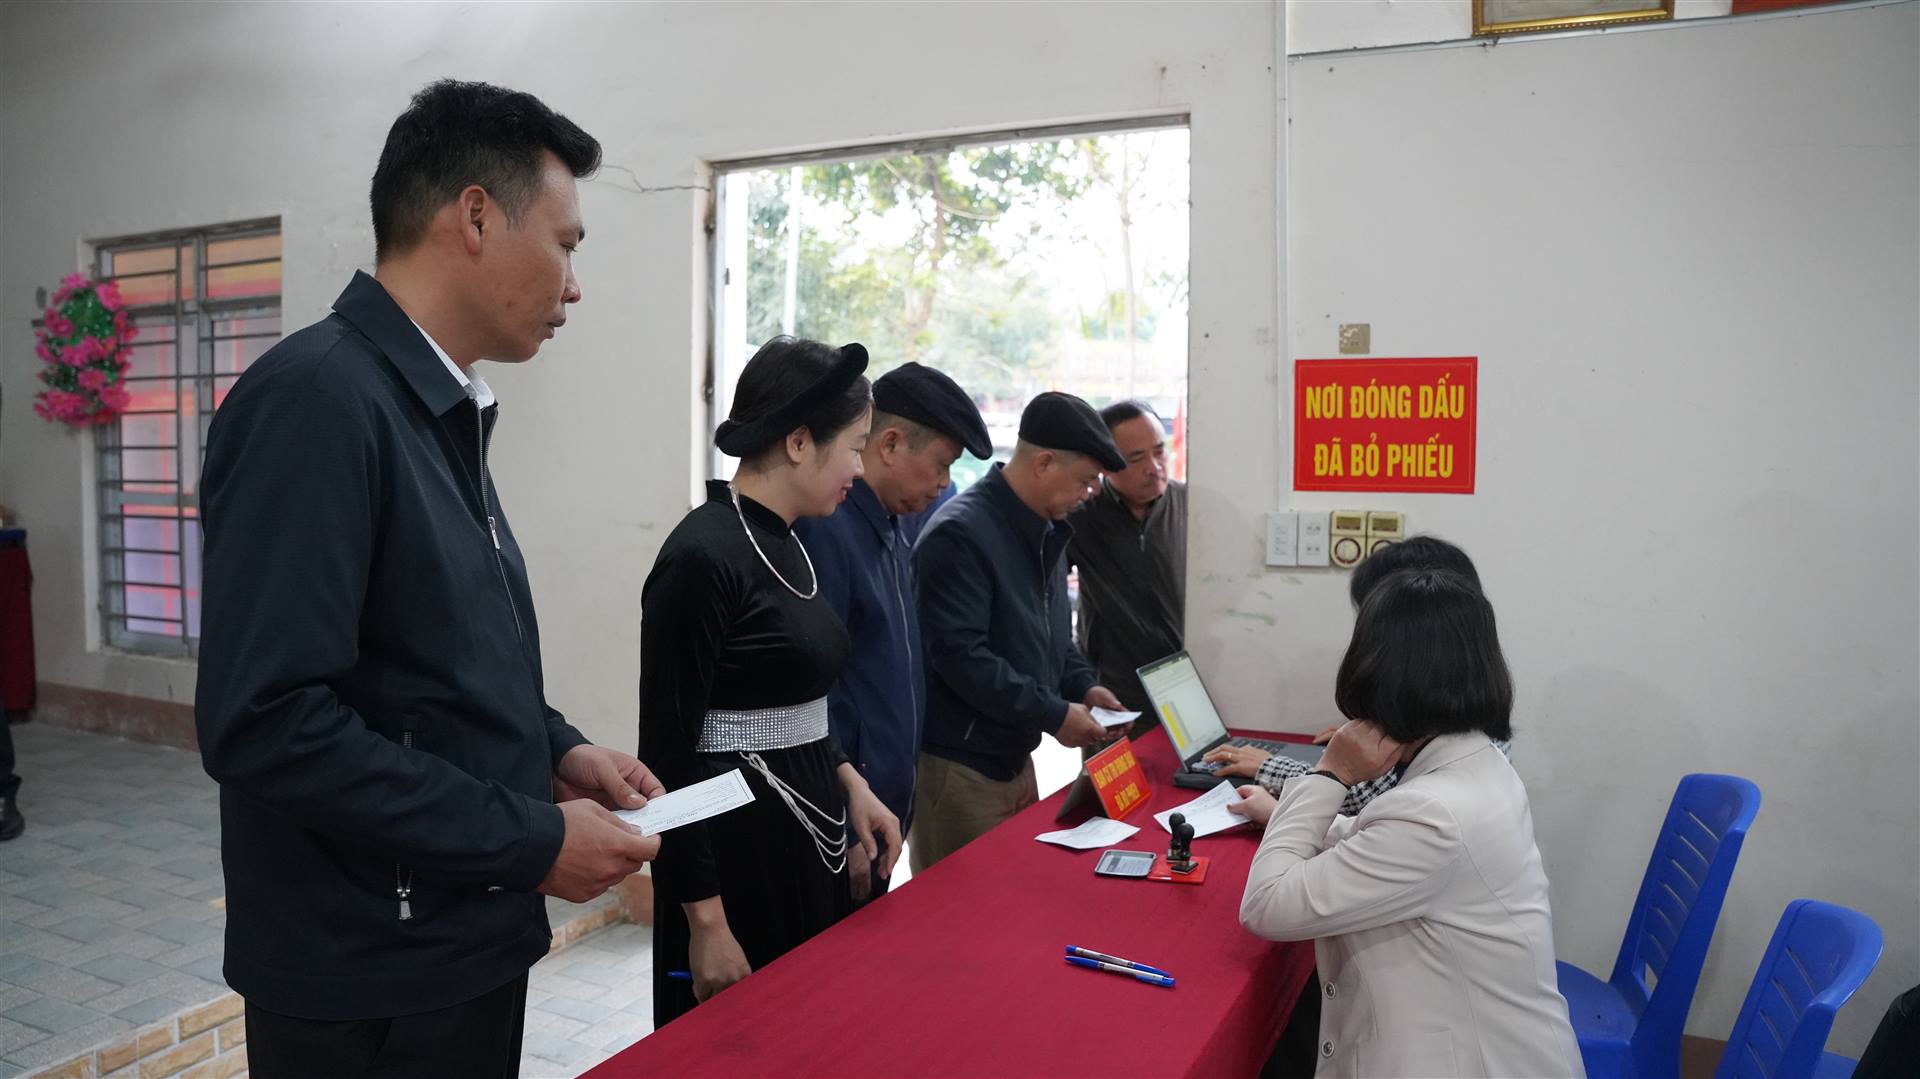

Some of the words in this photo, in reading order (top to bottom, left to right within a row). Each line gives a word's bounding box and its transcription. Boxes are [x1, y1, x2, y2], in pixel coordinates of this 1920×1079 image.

[1306, 383, 1343, 419] NƠI
[1350, 379, 1411, 418] ĐÓNG
[1419, 373, 1464, 418] DẤU
[1314, 438, 1343, 476] ĐÃ
[1351, 433, 1379, 477] BỎ
[1387, 433, 1453, 478] PHIẾU
